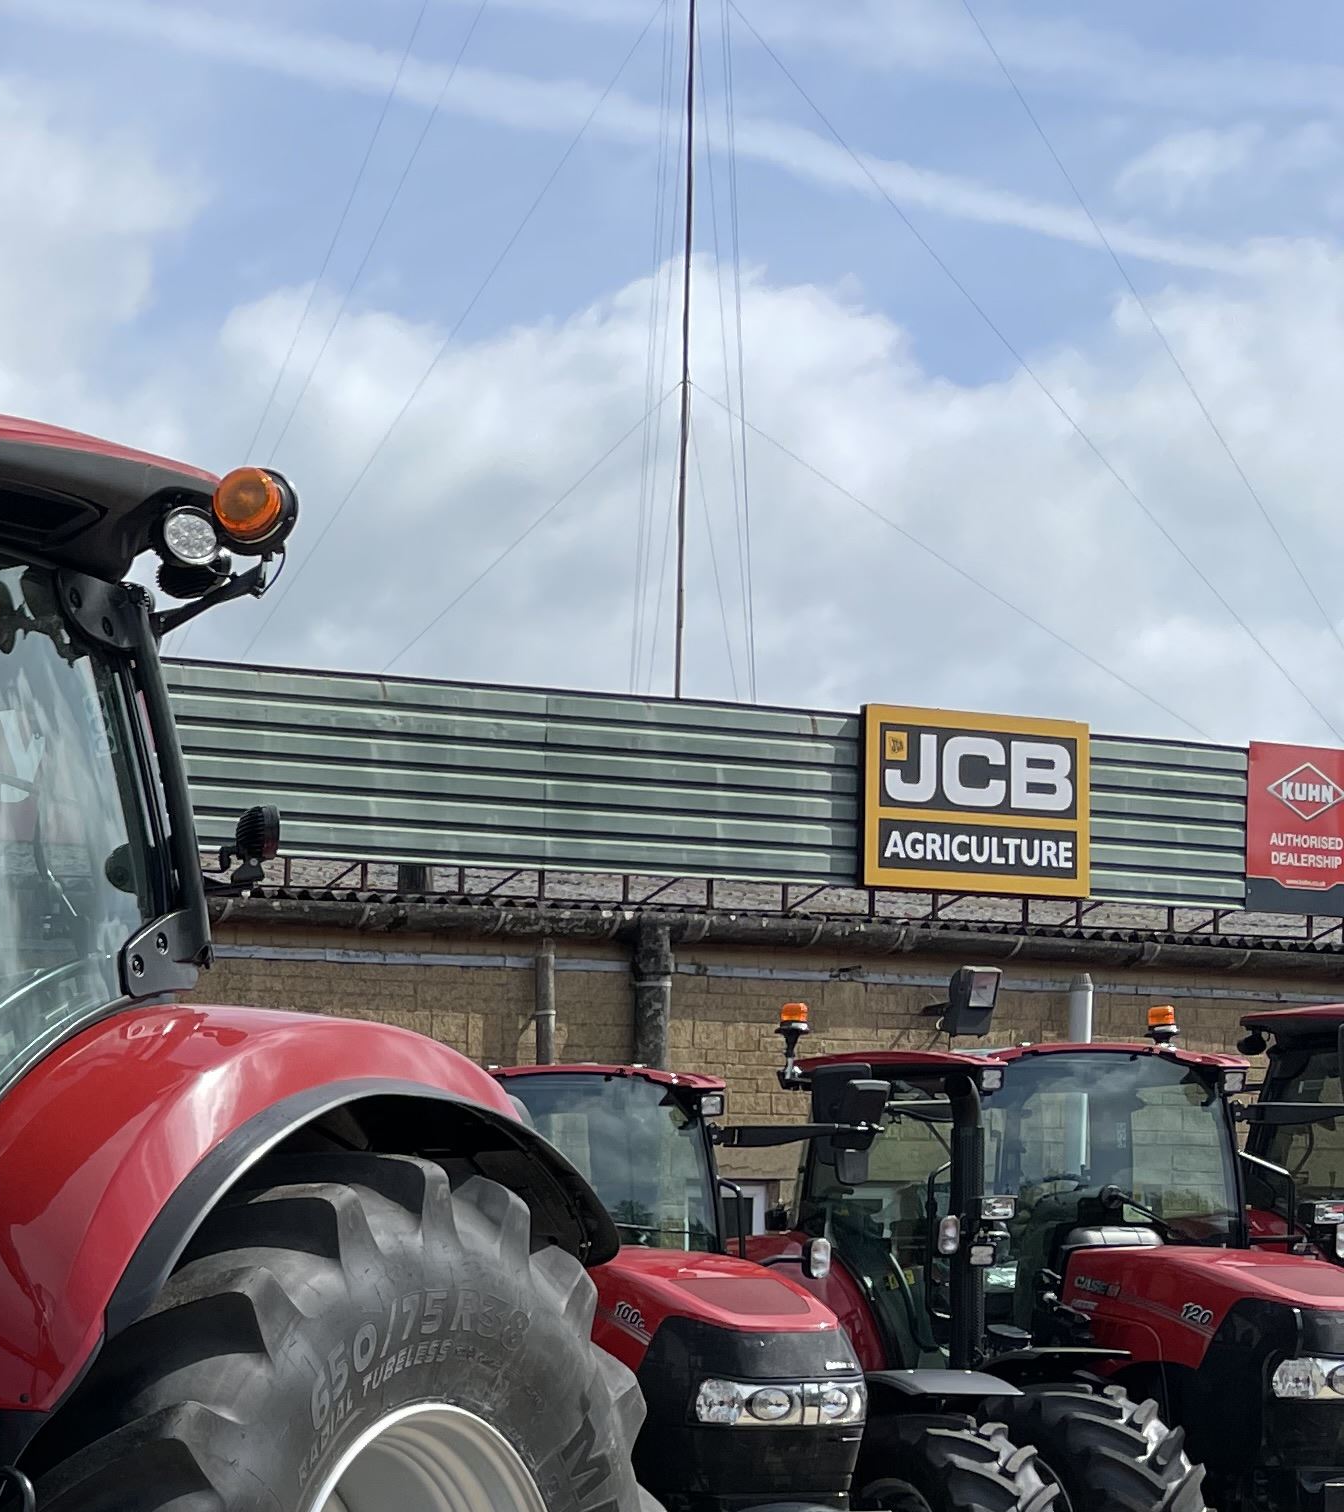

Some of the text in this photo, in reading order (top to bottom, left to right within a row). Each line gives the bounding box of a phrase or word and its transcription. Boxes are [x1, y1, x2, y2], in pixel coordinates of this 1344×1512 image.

[885, 733, 1073, 811] JCB
[1282, 781, 1333, 803] KUHN
[884, 830, 1073, 868] AGRICULTURE
[1269, 832, 1343, 851] AUTHORISED
[1271, 851, 1342, 869] DEALERSHIP
[1180, 1302, 1214, 1326] 120
[361, 1338, 455, 1398] TUBELESS
